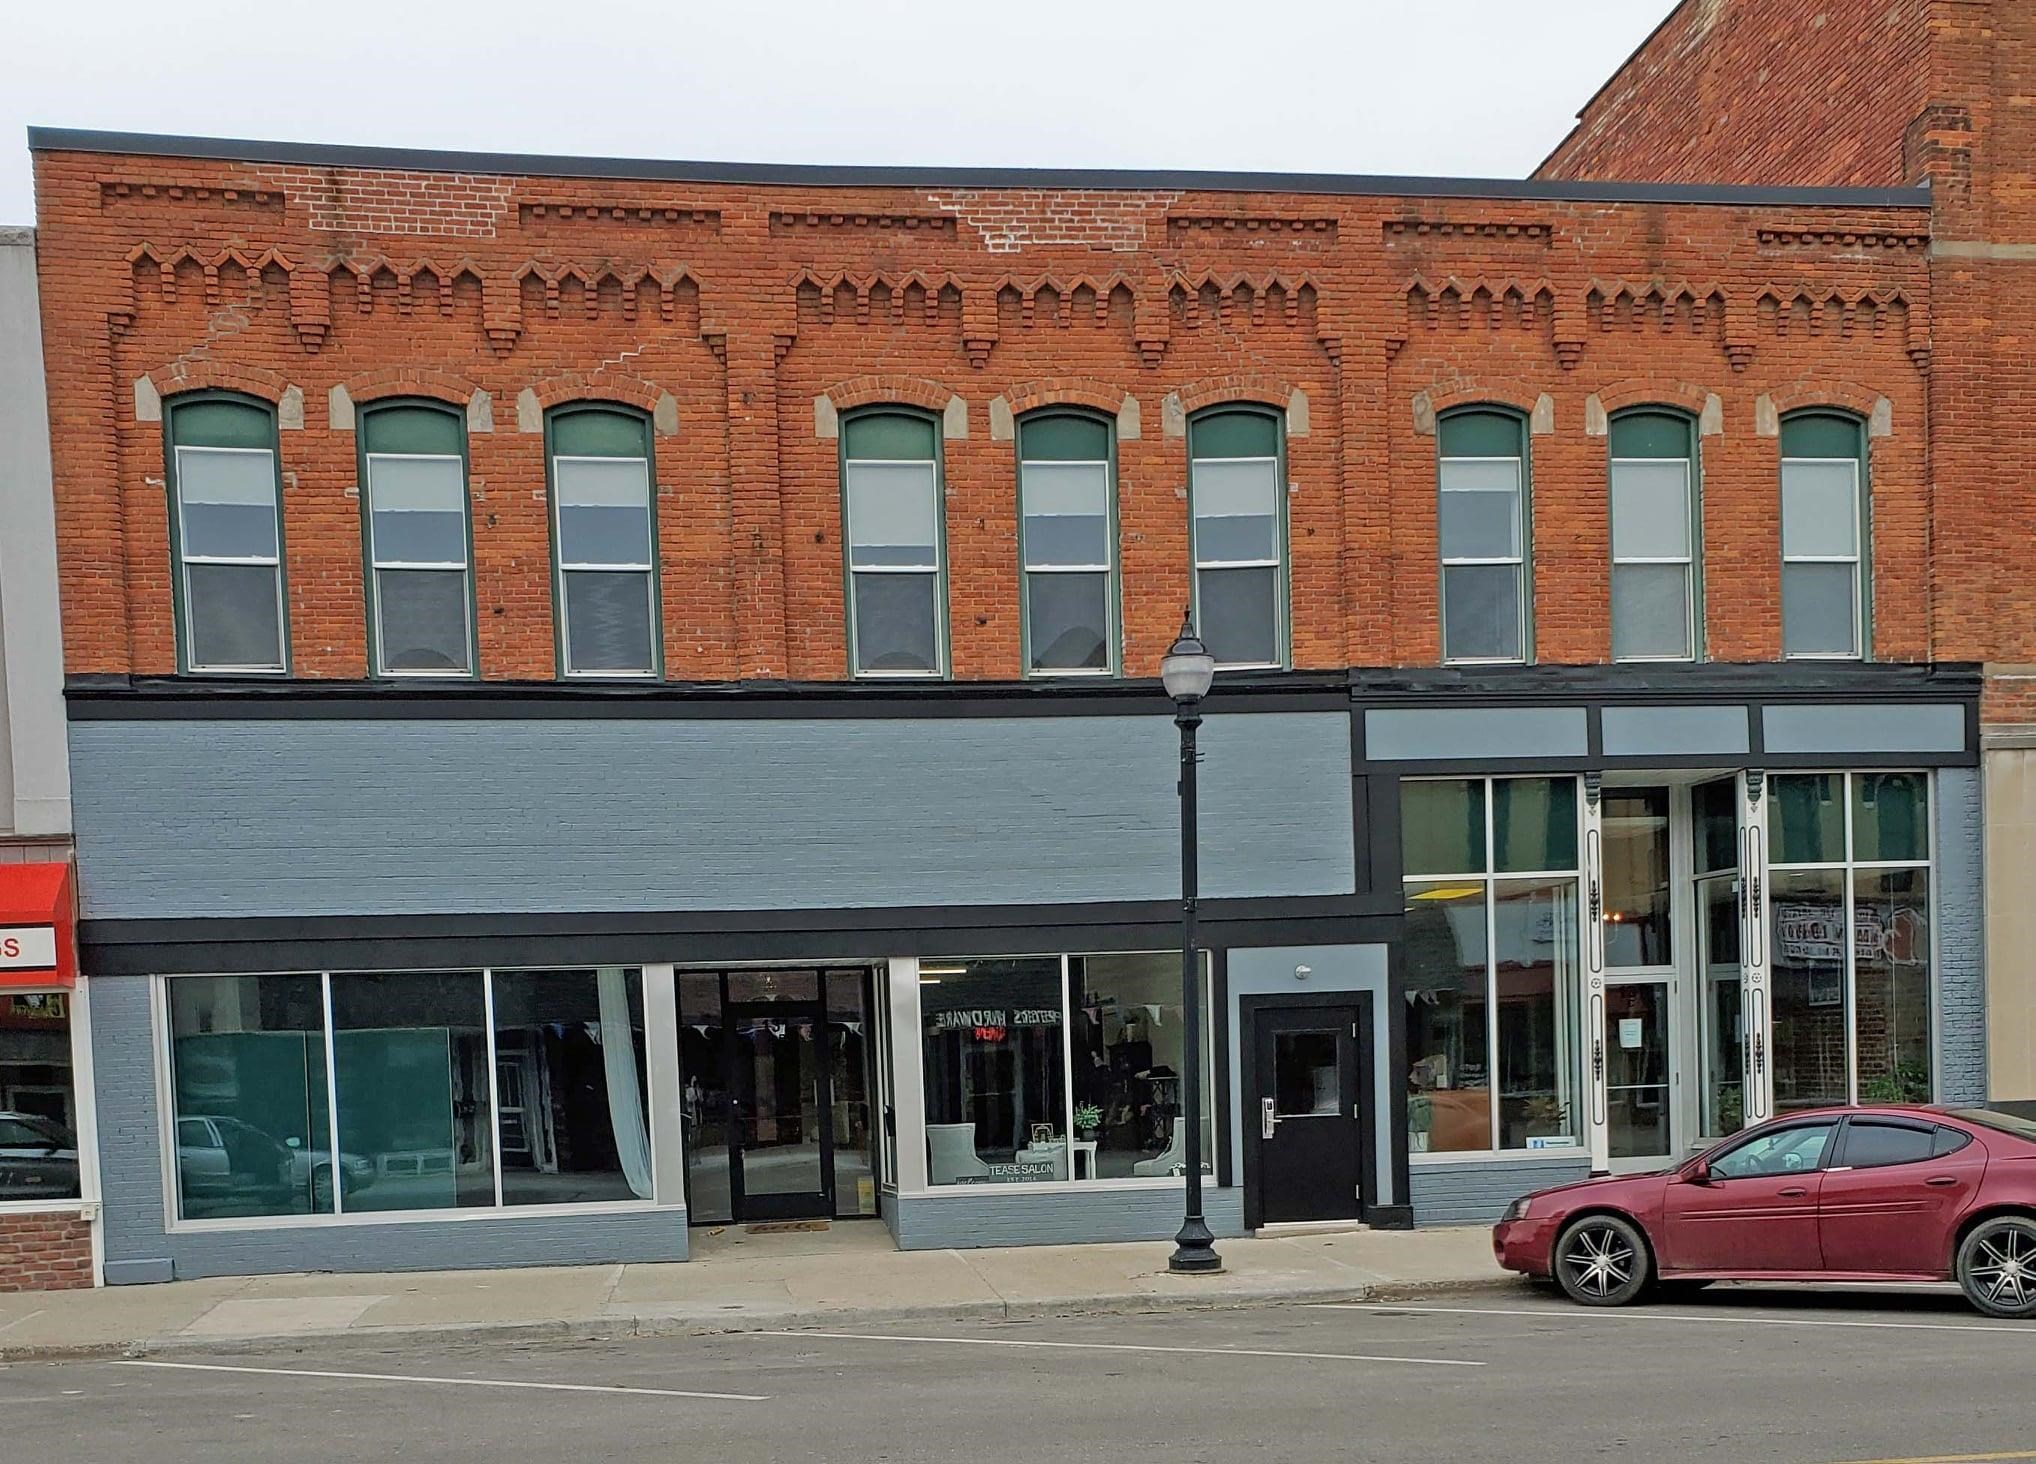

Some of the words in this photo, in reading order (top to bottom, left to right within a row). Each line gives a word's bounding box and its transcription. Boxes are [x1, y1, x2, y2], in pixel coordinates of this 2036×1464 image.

[0, 937, 20, 957] S
[989, 1164, 1021, 1176] TEASE
[1021, 1163, 1054, 1175] SALON
